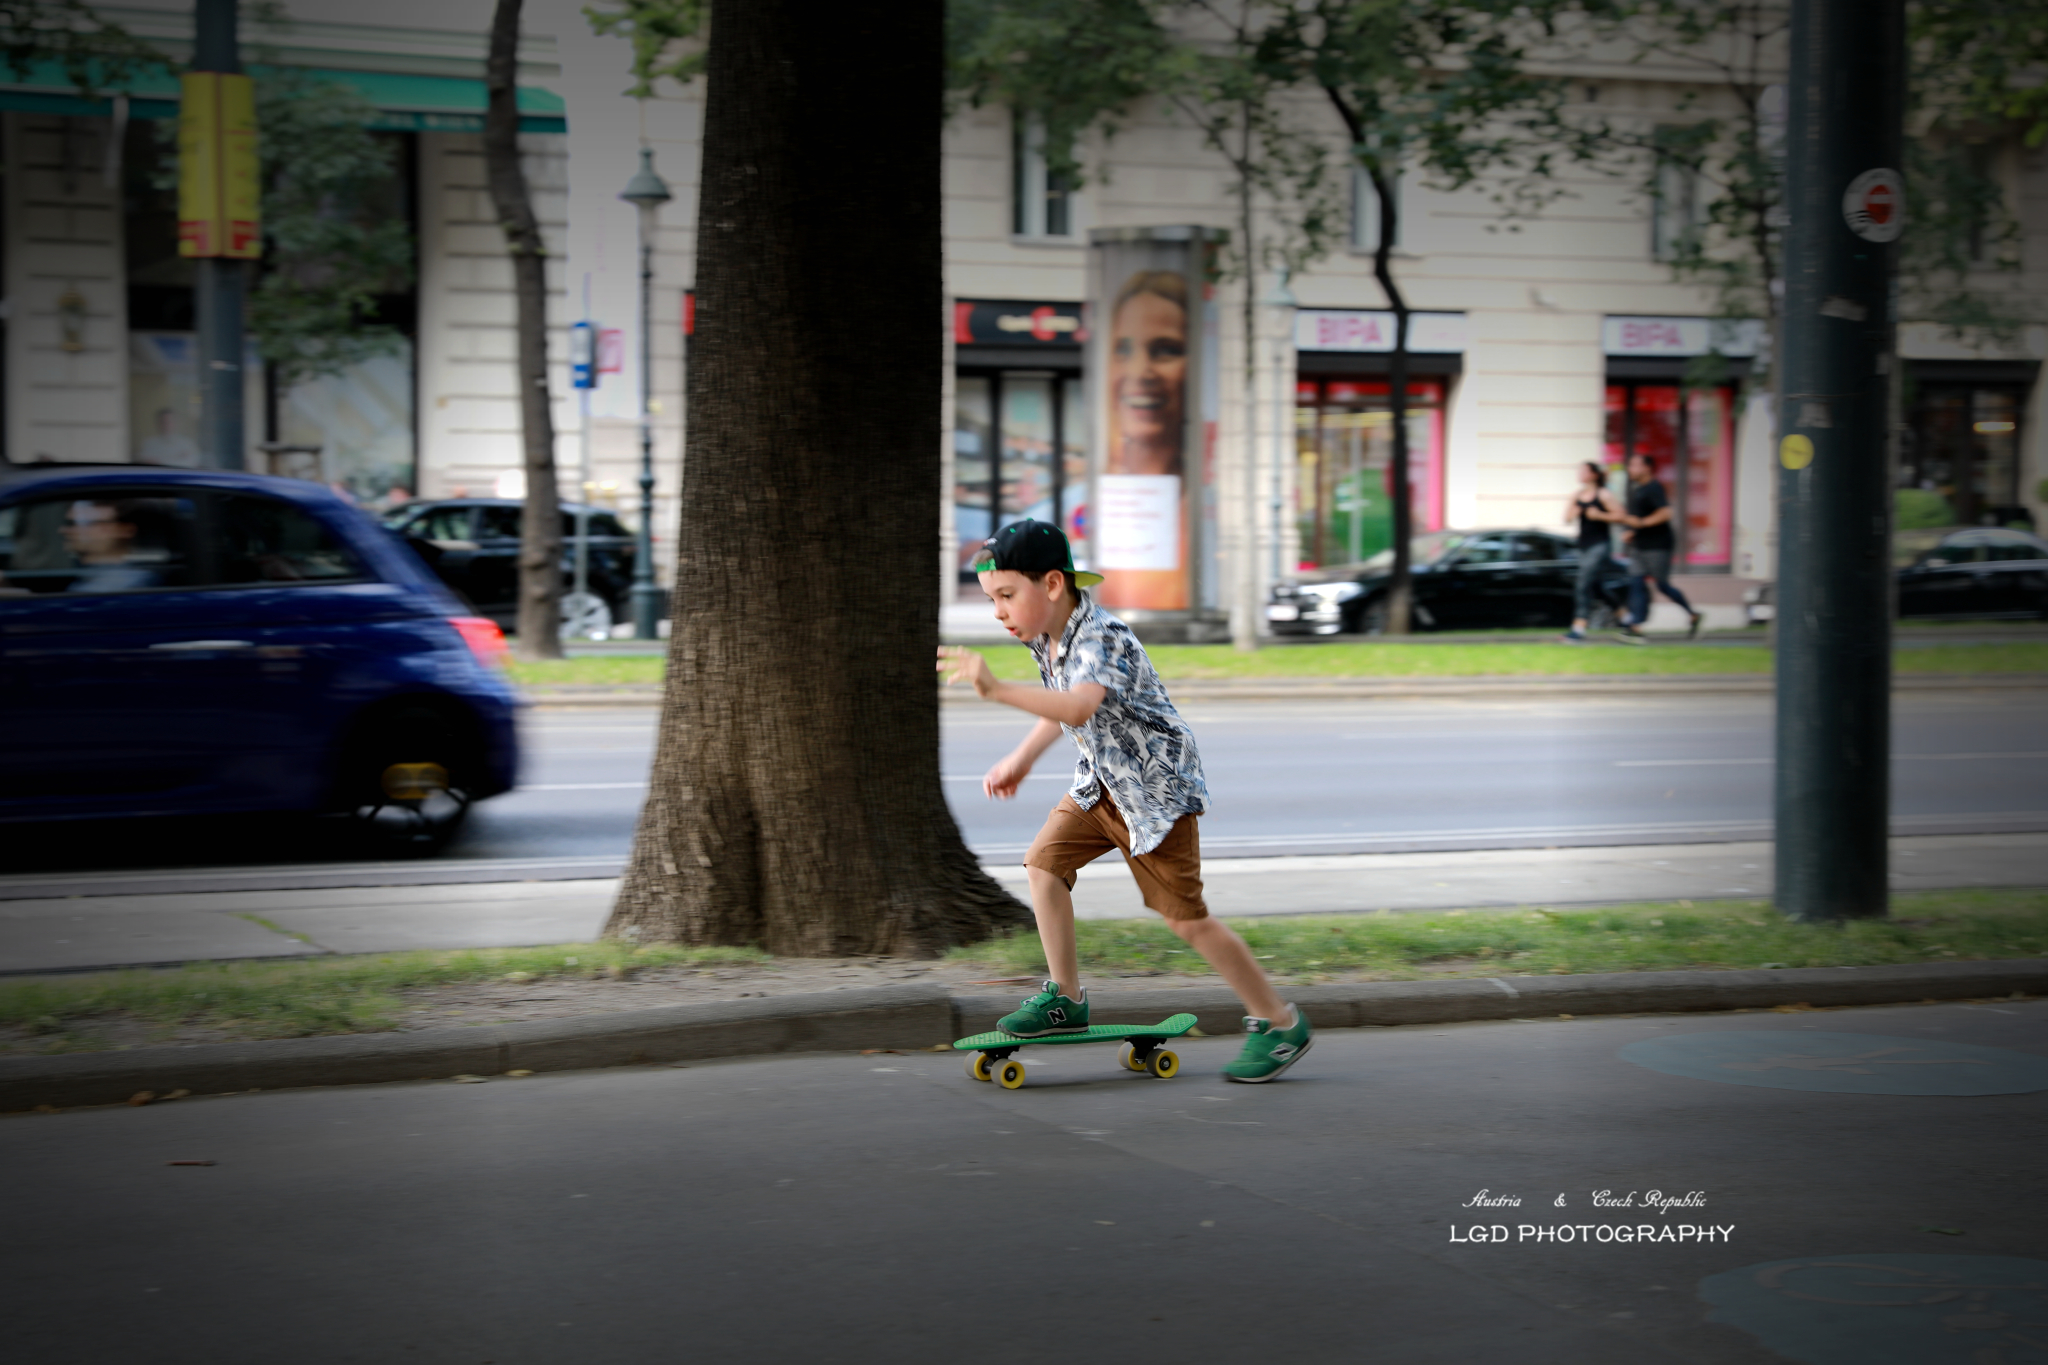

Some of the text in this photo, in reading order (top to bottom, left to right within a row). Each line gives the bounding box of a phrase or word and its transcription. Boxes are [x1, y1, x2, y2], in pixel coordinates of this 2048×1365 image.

[1316, 317, 1383, 346] BIPA
[1621, 322, 1684, 349] BIPA
[1048, 1007, 1067, 1025] N
